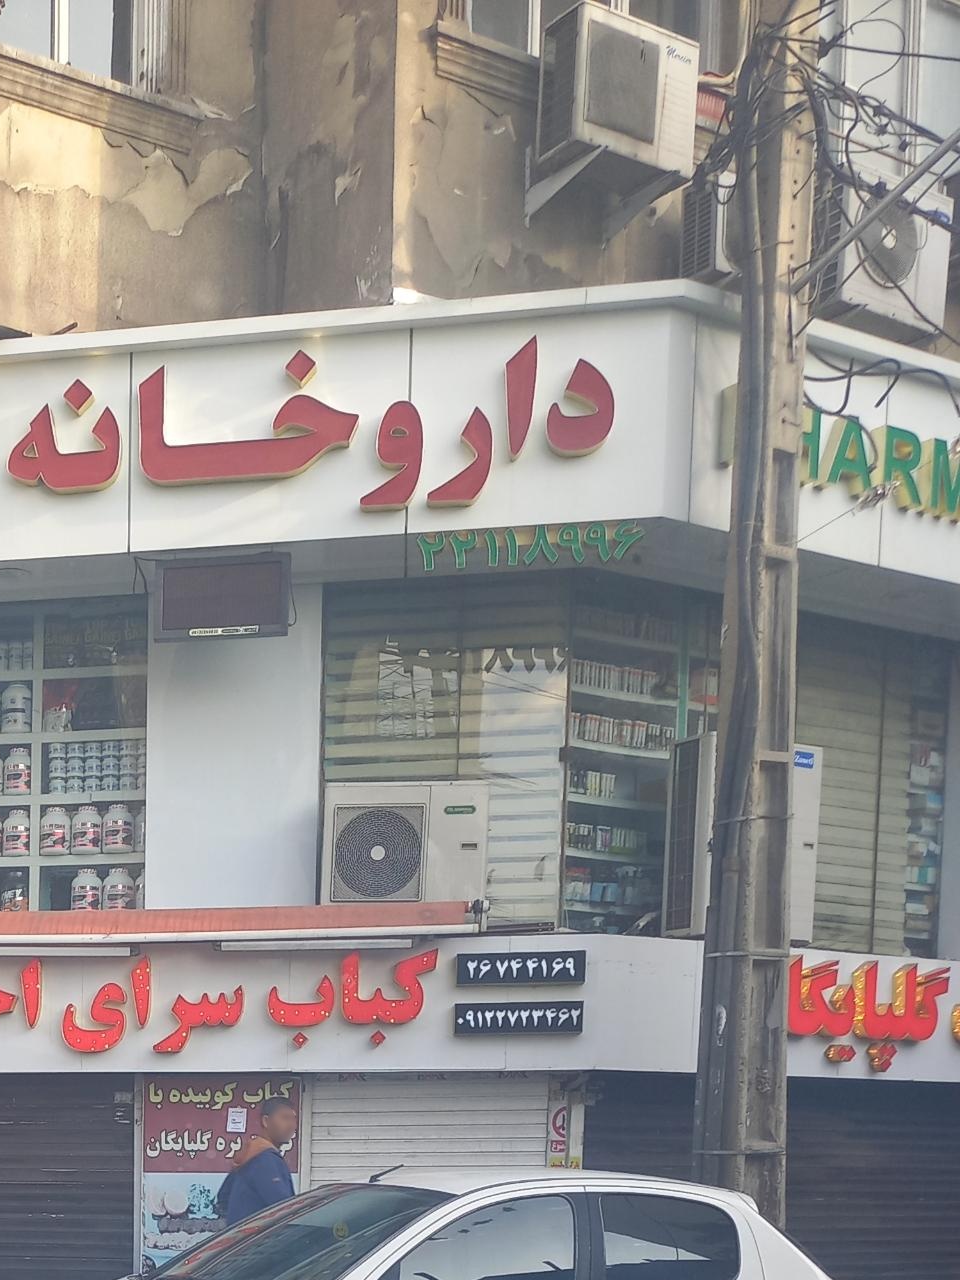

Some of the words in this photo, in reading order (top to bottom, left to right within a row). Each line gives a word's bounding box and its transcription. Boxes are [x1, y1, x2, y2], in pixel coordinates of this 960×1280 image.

[6, 334, 615, 511] داروخانه
[416, 519, 646, 572] ۲۲۱۱۸۹۹۶
[466, 956, 576, 979] ۲۶۷۴۴۱۶۹
[61, 954, 246, 1053] سرای
[268, 948, 439, 1048] کباب
[456, 1007, 581, 1028] ۰۹۱۲۲۷۲۳۴۶۲
[148, 1082, 164, 1109] با
[169, 1081, 239, 1110] کوبیده
[146, 1129, 214, 1159] گلپایگان
